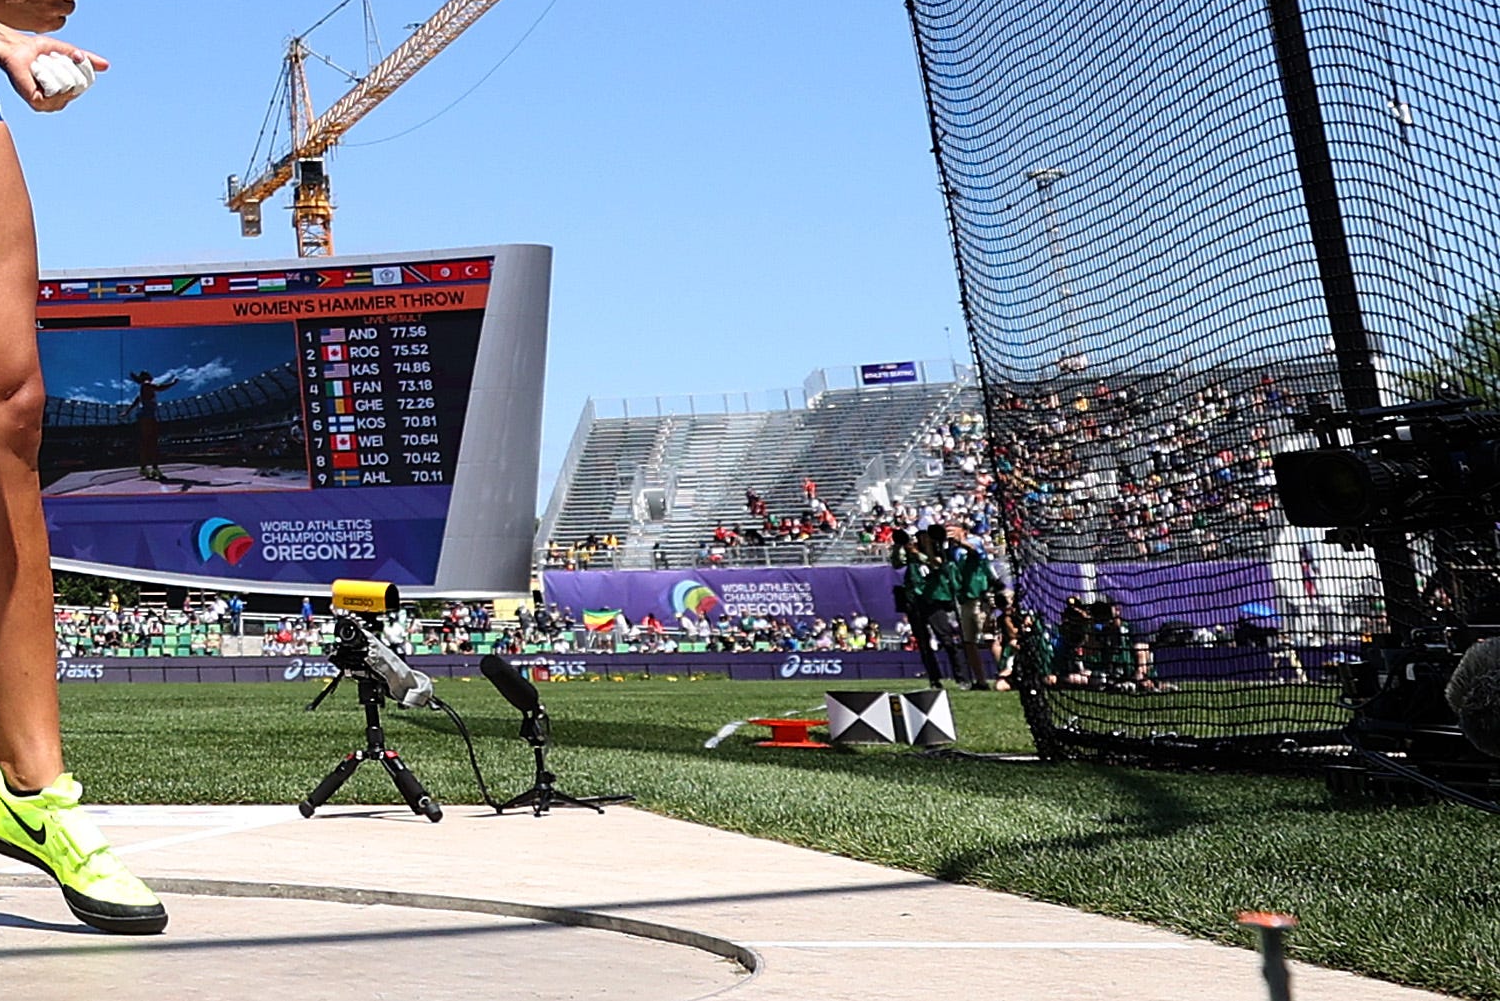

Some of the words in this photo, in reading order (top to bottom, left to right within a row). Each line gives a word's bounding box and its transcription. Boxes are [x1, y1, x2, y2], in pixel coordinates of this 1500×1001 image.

[233, 296, 315, 316] WOMEN'S
[320, 294, 396, 312] HAMMER
[402, 291, 465, 306] THROW
[363, 315, 385, 325] LIVE
[387, 314, 423, 324] RESULT
[305, 332, 312, 342] 1
[348, 328, 378, 341] AND
[390, 326, 427, 338] 77.56
[306, 350, 316, 361] 2
[350, 346, 380, 358] ROG
[391, 344, 429, 356] 75.52
[308, 367, 317, 378] 3
[351, 363, 380, 376] KAS
[393, 362, 431, 374] 74.86
[309, 384, 319, 395] 4
[353, 381, 382, 394] FAN
[398, 380, 433, 392] 73.18
[311, 402, 321, 413] 5
[355, 399, 384, 411] GHE
[397, 398, 435, 410] 72.26
[312, 420, 322, 431] 6
[357, 417, 386, 429] KOS
[402, 416, 437, 428] 70.81
[314, 437, 323, 449] 7
[358, 435, 384, 447] WEI
[401, 434, 439, 446] 70.64
[316, 456, 326, 467] 8
[360, 453, 389, 466] LUO
[403, 452, 441, 464] 70.42
[318, 474, 327, 485] 9
[362, 471, 391, 484] AHL
[411, 470, 443, 482] 70.11
[260, 520, 304, 532] WORLD
[307, 519, 373, 531] ATHLETICS
[261, 531, 374, 544] CHAMPIONSHIPS
[721, 583, 757, 592] WORLD
[759, 582, 812, 592] ATHLETICS
[723, 592, 813, 603] CHAMPIONSHIPS
[66, 661, 103, 679] asics
[303, 661, 341, 678] asics
[801, 658, 842, 675] asics
